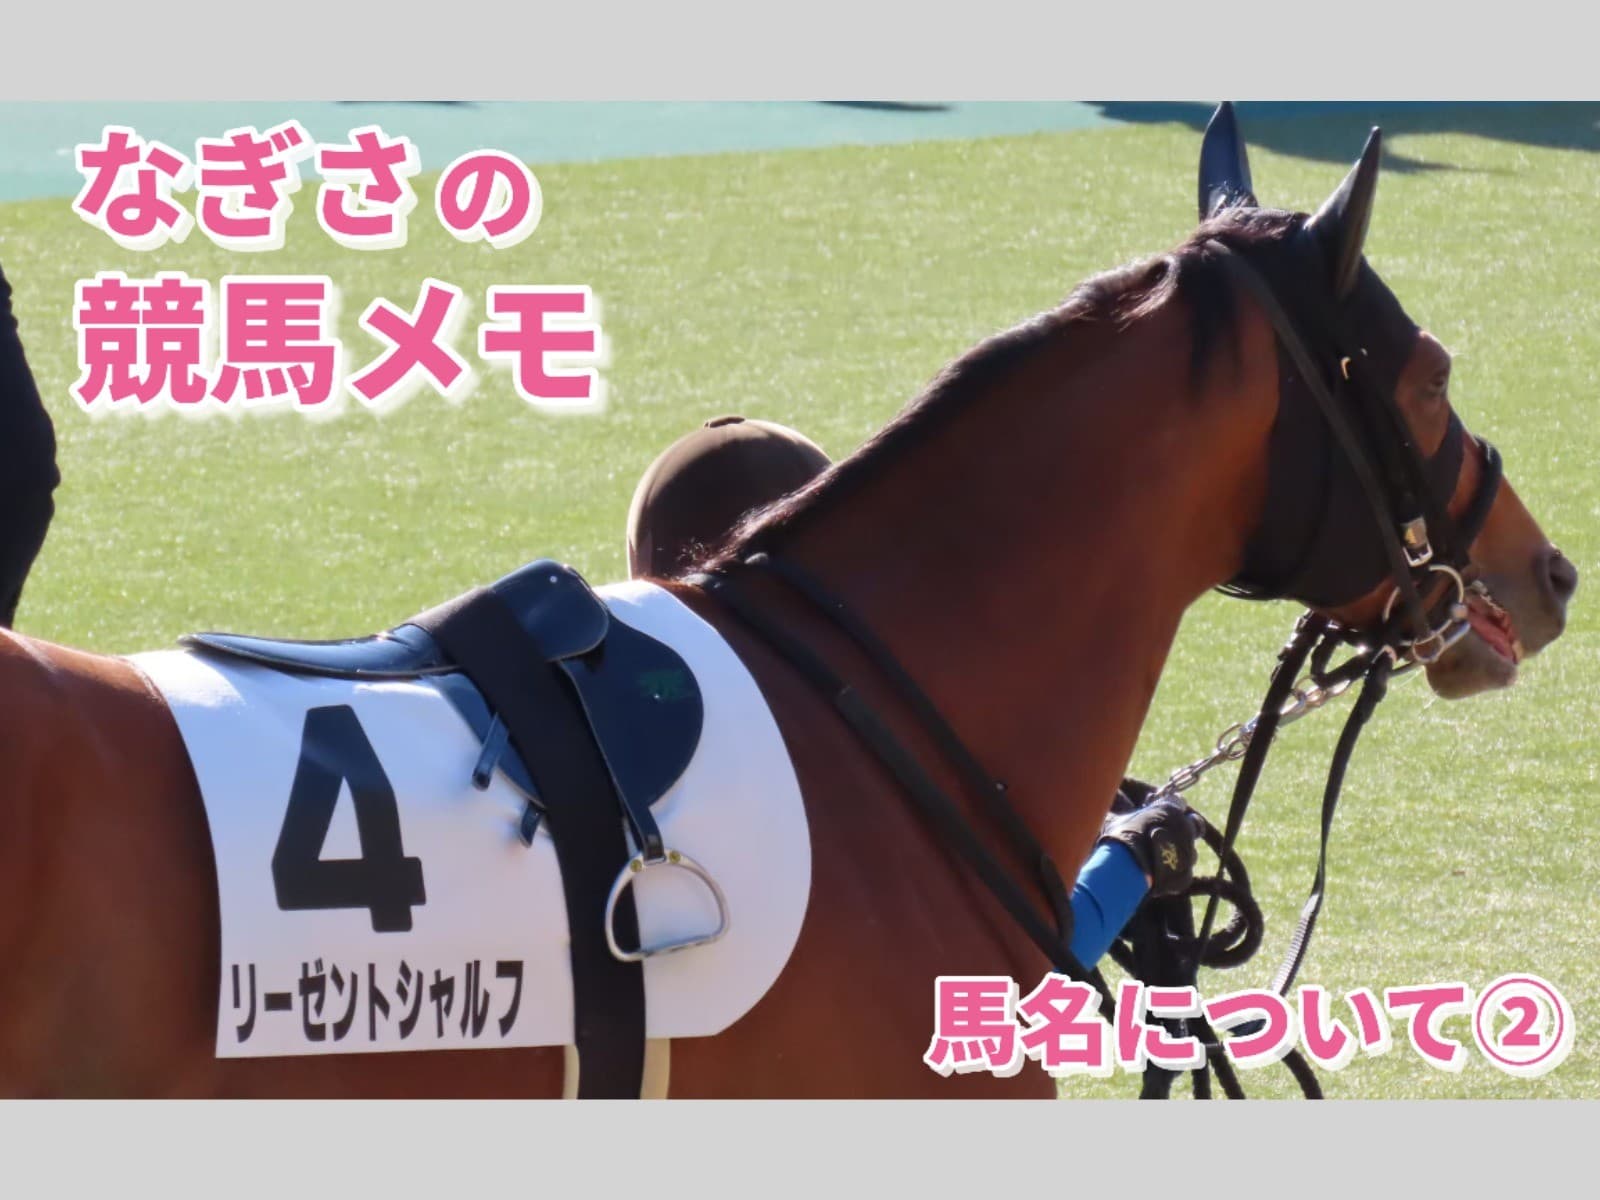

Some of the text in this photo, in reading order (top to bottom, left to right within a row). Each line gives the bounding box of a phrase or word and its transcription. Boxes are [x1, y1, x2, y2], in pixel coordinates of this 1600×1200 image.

[272, 704, 426, 933] 4
[232, 957, 524, 1043] リーゼントシャルフ
